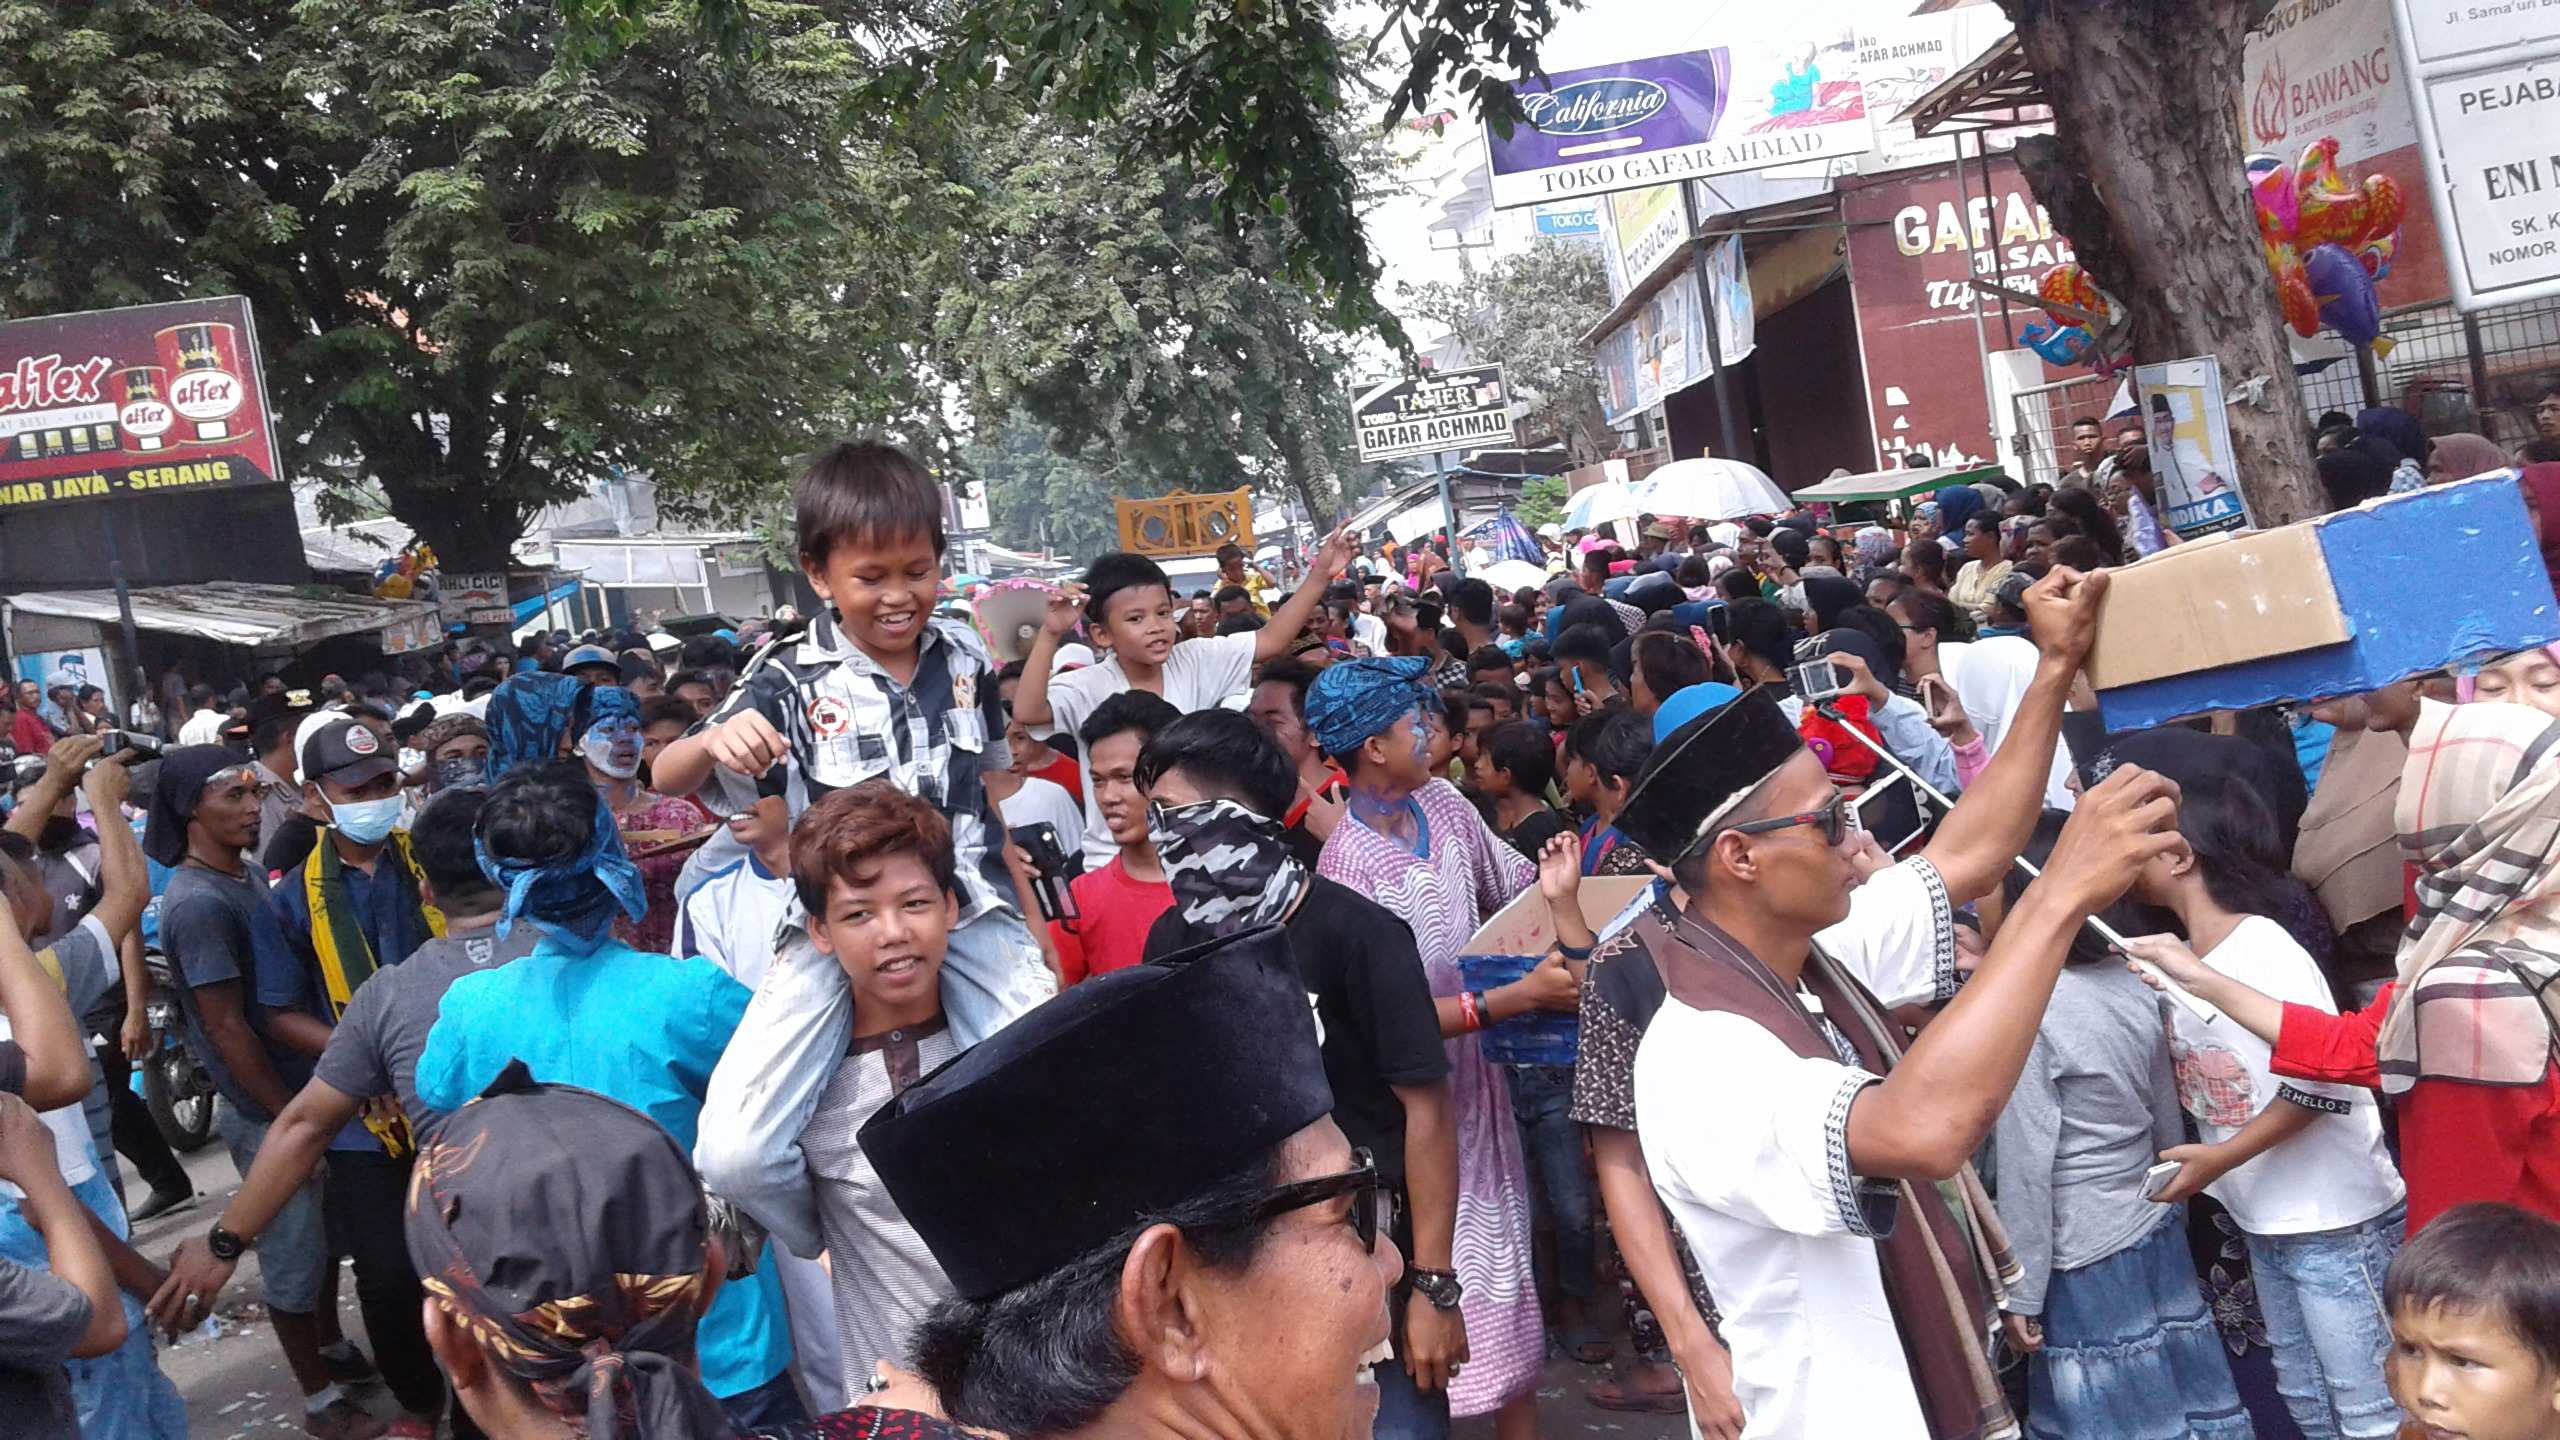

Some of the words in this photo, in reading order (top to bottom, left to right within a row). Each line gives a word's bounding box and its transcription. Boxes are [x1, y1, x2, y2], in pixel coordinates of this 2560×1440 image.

[1860, 48, 1889, 64] AFAR
[1892, 39, 1943, 58] ACHMAD
[2290, 47, 2391, 117] BAWANG
[2460, 78, 2560, 114] PEJAB
[1522, 89, 1661, 132] California
[1540, 164, 1615, 192] TOKO
[1624, 148, 1715, 180] GAFAR
[1722, 133, 1823, 164] AHMAD
[2483, 159, 2541, 200] ENI
[1551, 213, 1583, 228] TOKO
[2511, 216, 2543, 236] SK.
[2489, 241, 2557, 265] NOMOR
[1361, 412, 1397, 427] TOKO
[1363, 425, 1422, 449] GAFAR
[1427, 412, 1507, 441] ACHMAD
[52, 475, 110, 500] JAYA
[128, 462, 231, 490] SERANG
[2292, 1091, 2336, 1111] HELLO
